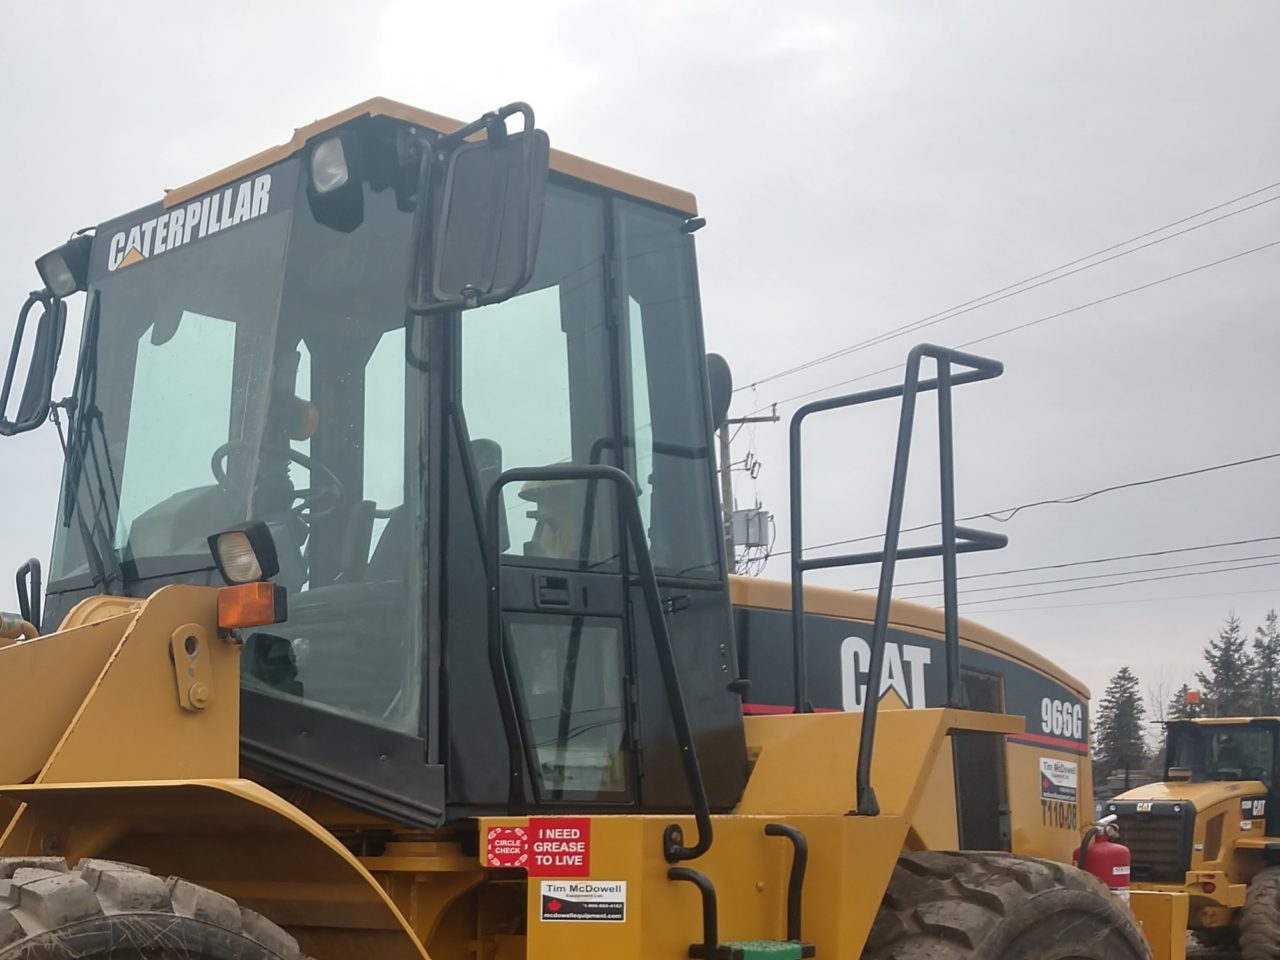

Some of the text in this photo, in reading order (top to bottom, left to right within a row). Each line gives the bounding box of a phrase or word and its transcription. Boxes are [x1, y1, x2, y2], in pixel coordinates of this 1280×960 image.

[108, 174, 271, 271] CATERPILLAR
[841, 636, 931, 712] CAT
[1041, 697, 1082, 739] 966G
[1137, 802, 1153, 812] CAT
[539, 829, 581, 839] I NEED
[533, 842, 585, 852] GREASE
[535, 855, 583, 866] TO LIVE
[546, 884, 622, 893] Tim McDowell
